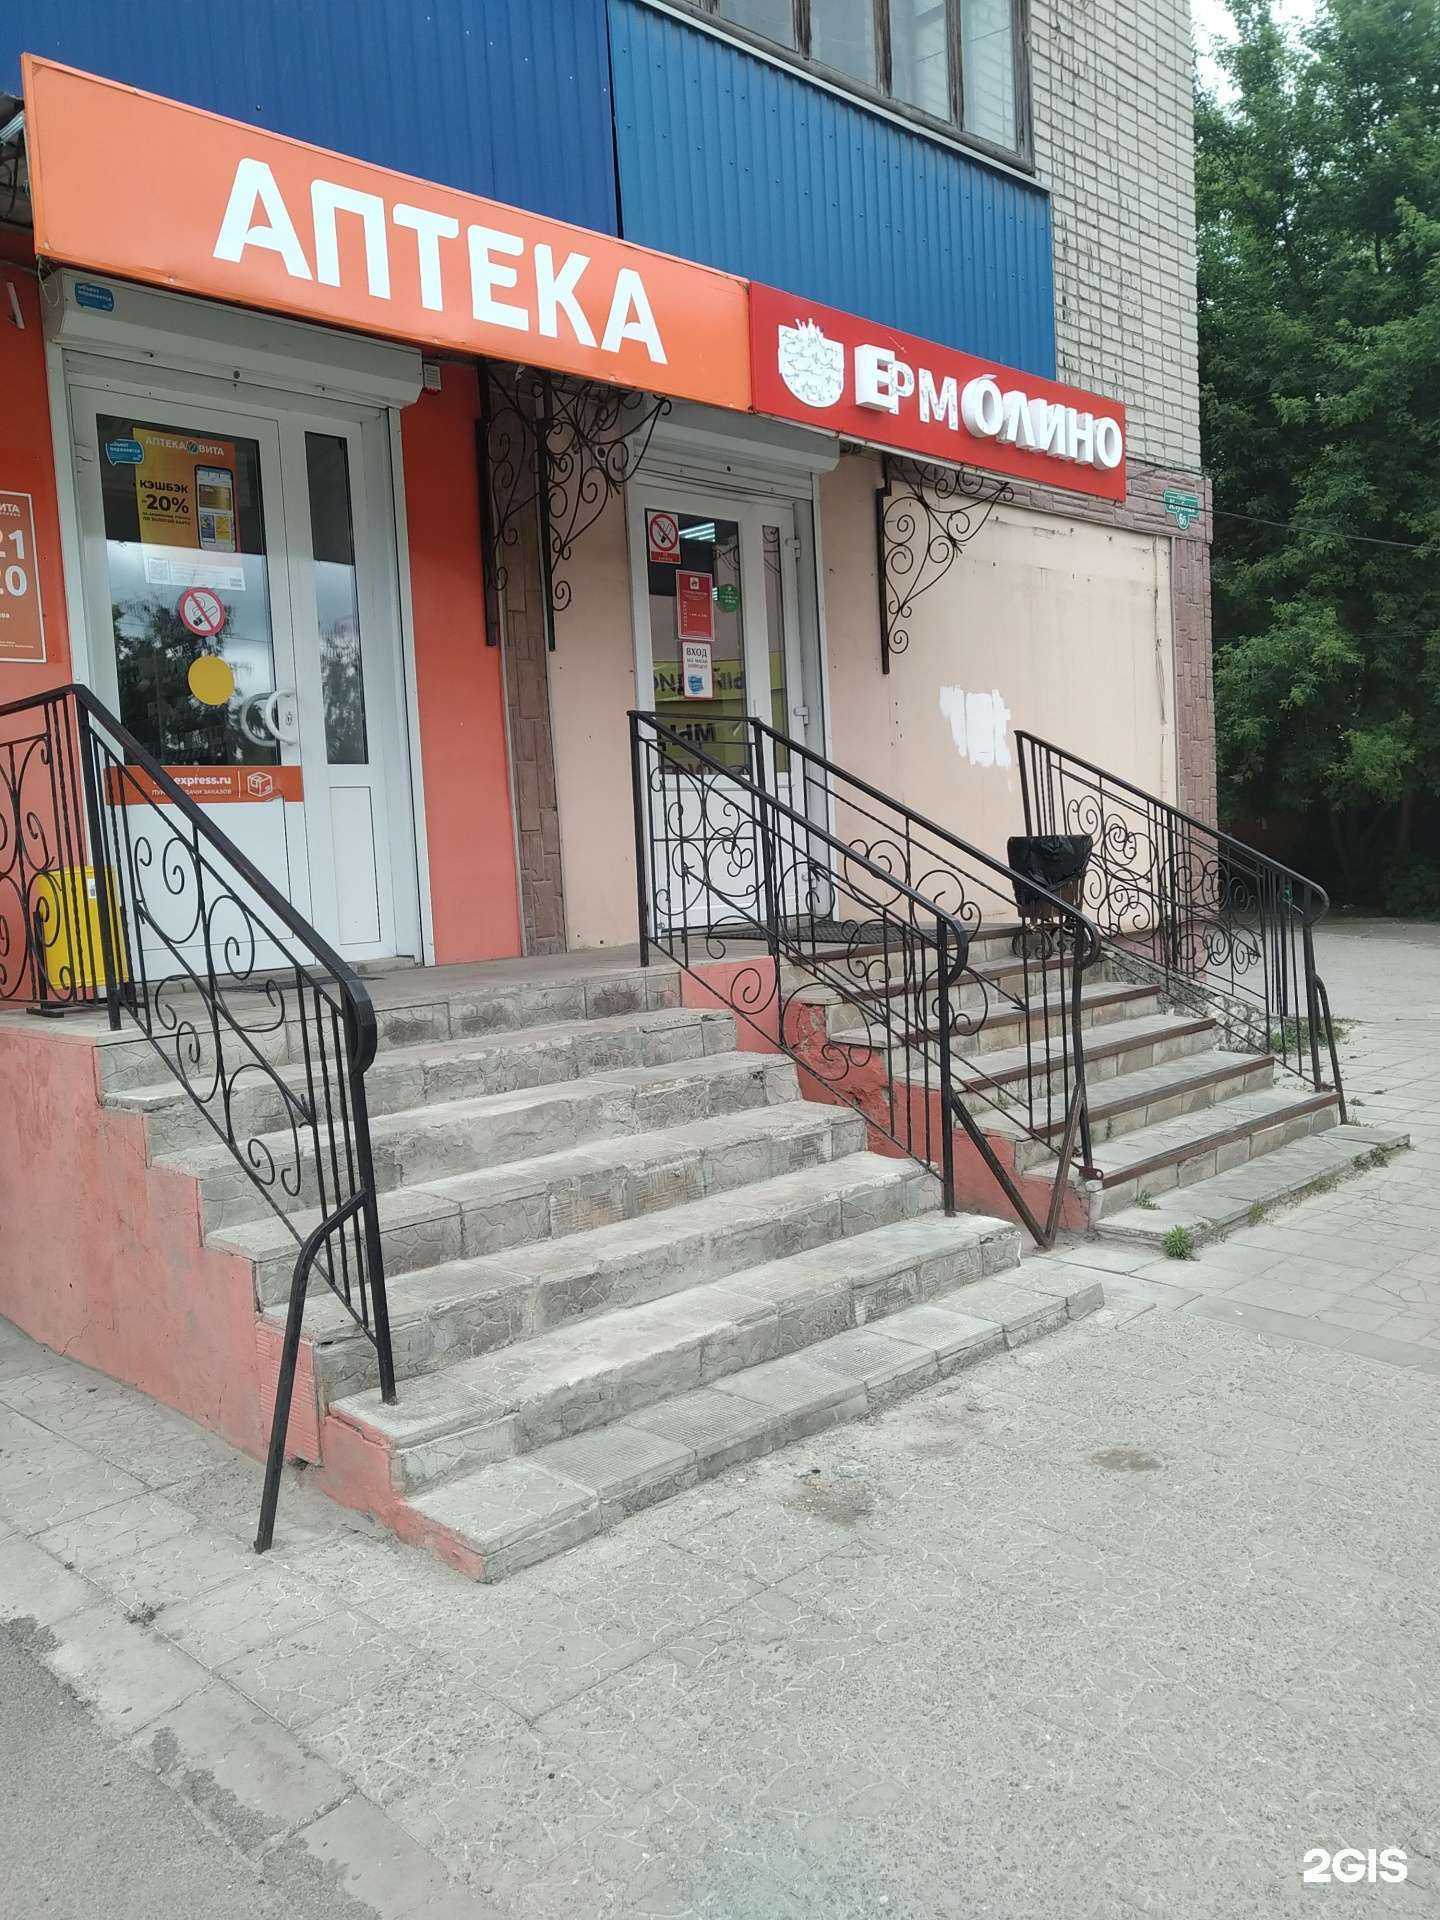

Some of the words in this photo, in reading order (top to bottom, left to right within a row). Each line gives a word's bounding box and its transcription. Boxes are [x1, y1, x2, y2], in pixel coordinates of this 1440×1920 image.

[212, 157, 668, 365] АПТЕКА
[145, 436, 187, 450] АПТЕКА
[198, 443, 225, 456] ВИТА
[140, 479, 189, 493] КЭШБЭК
[146, 494, 189, 514] 20%
[686, 647, 708, 659] ВХОД
